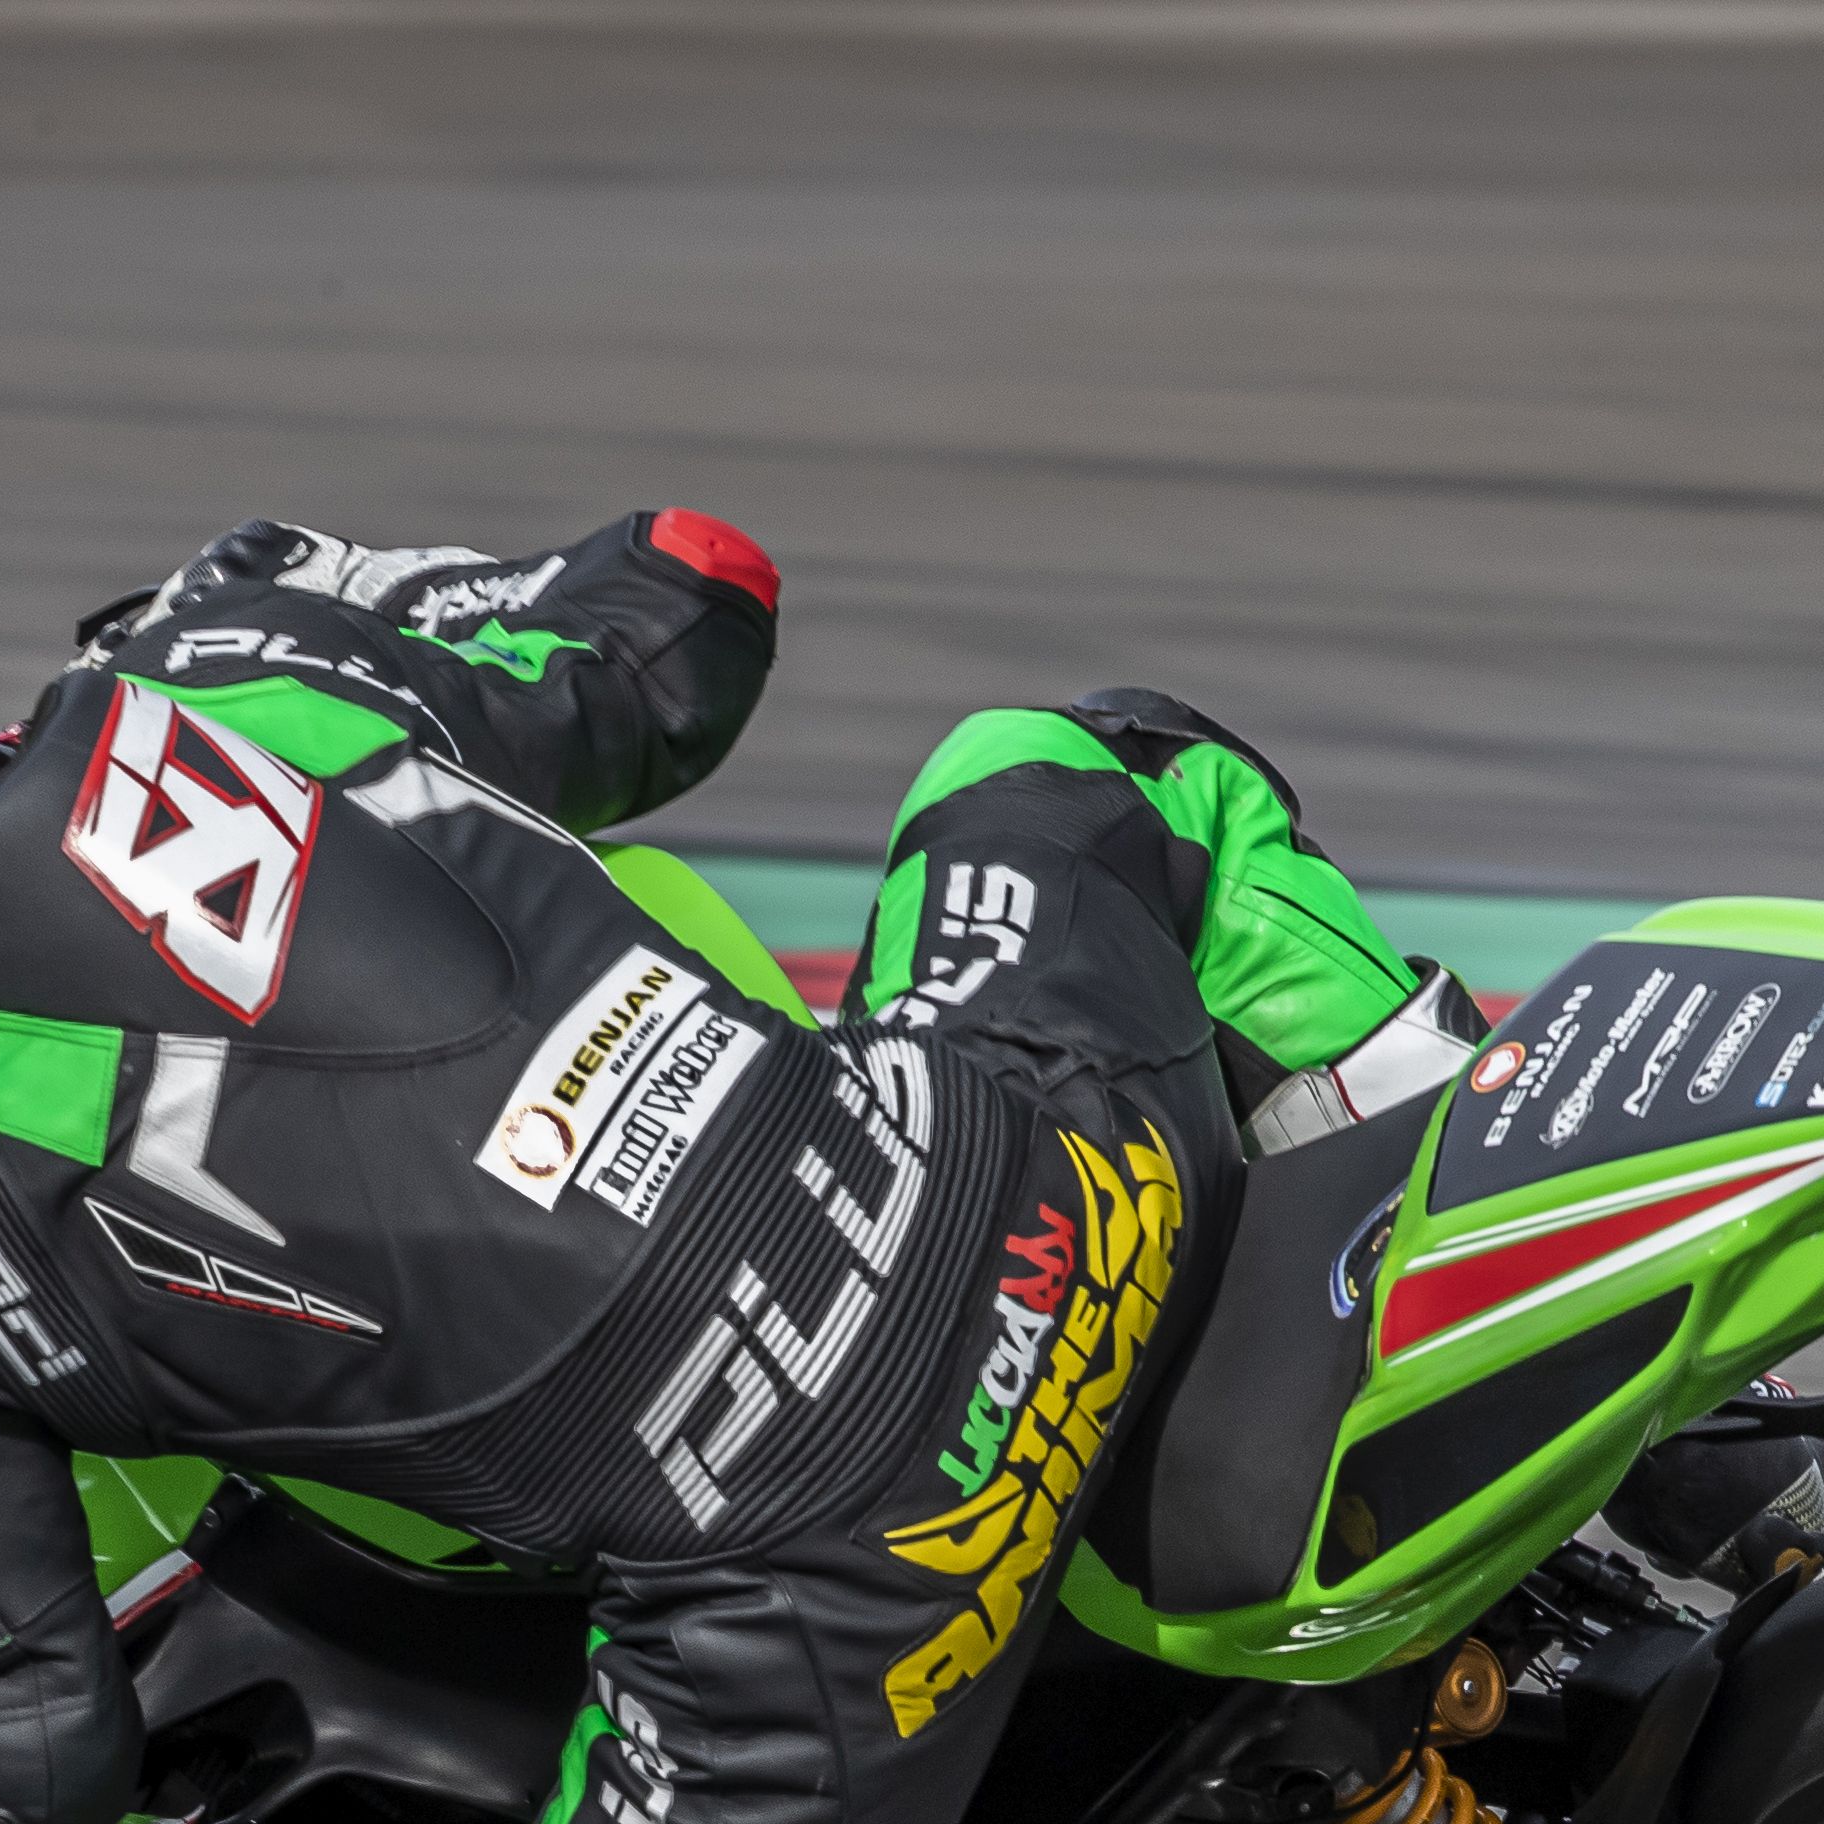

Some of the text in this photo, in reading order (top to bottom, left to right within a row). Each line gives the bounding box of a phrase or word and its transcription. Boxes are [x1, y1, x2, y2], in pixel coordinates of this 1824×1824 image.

[552, 966, 672, 1107] BENJAN
[609, 1011, 664, 1076] RACING
[1484, 984, 1594, 1147] BENJAN
[1530, 1022, 1580, 1098] RACING
[1623, 983, 1707, 1117] MRP
[1695, 993, 1766, 1095] ARROW
[589, 1014, 738, 1208] Emil Weber
[883, 1115, 1184, 1740] ANIMAL
[1007, 1285, 1111, 1465] THE
